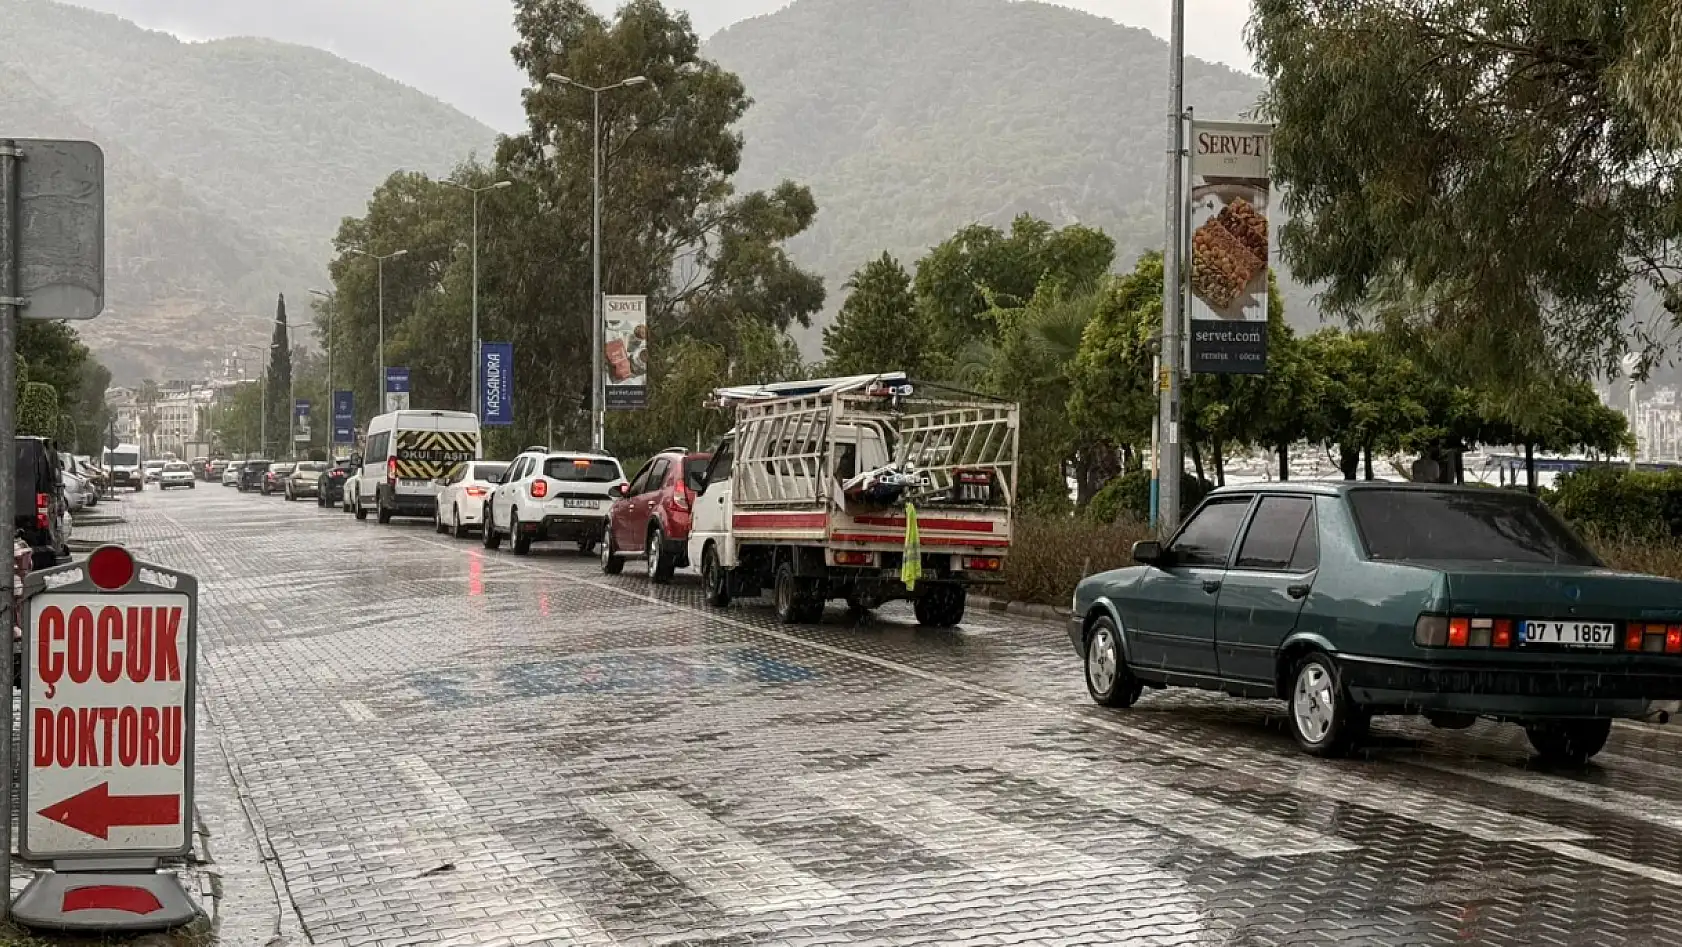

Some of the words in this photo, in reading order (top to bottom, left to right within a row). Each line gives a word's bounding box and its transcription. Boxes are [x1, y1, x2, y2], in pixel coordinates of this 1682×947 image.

[1198, 132, 1265, 157] SERVET
[608, 300, 643, 312] SERVET
[1195, 330, 1261, 342] servet.com
[487, 352, 500, 416] KASSANDRA
[401, 450, 433, 460] OKUL
[1527, 623, 1547, 640] 07
[1554, 623, 1564, 641] Y
[1573, 624, 1613, 643] 1867
[37, 605, 183, 698] ÇOCUK
[34, 705, 182, 768] DOKTORU
